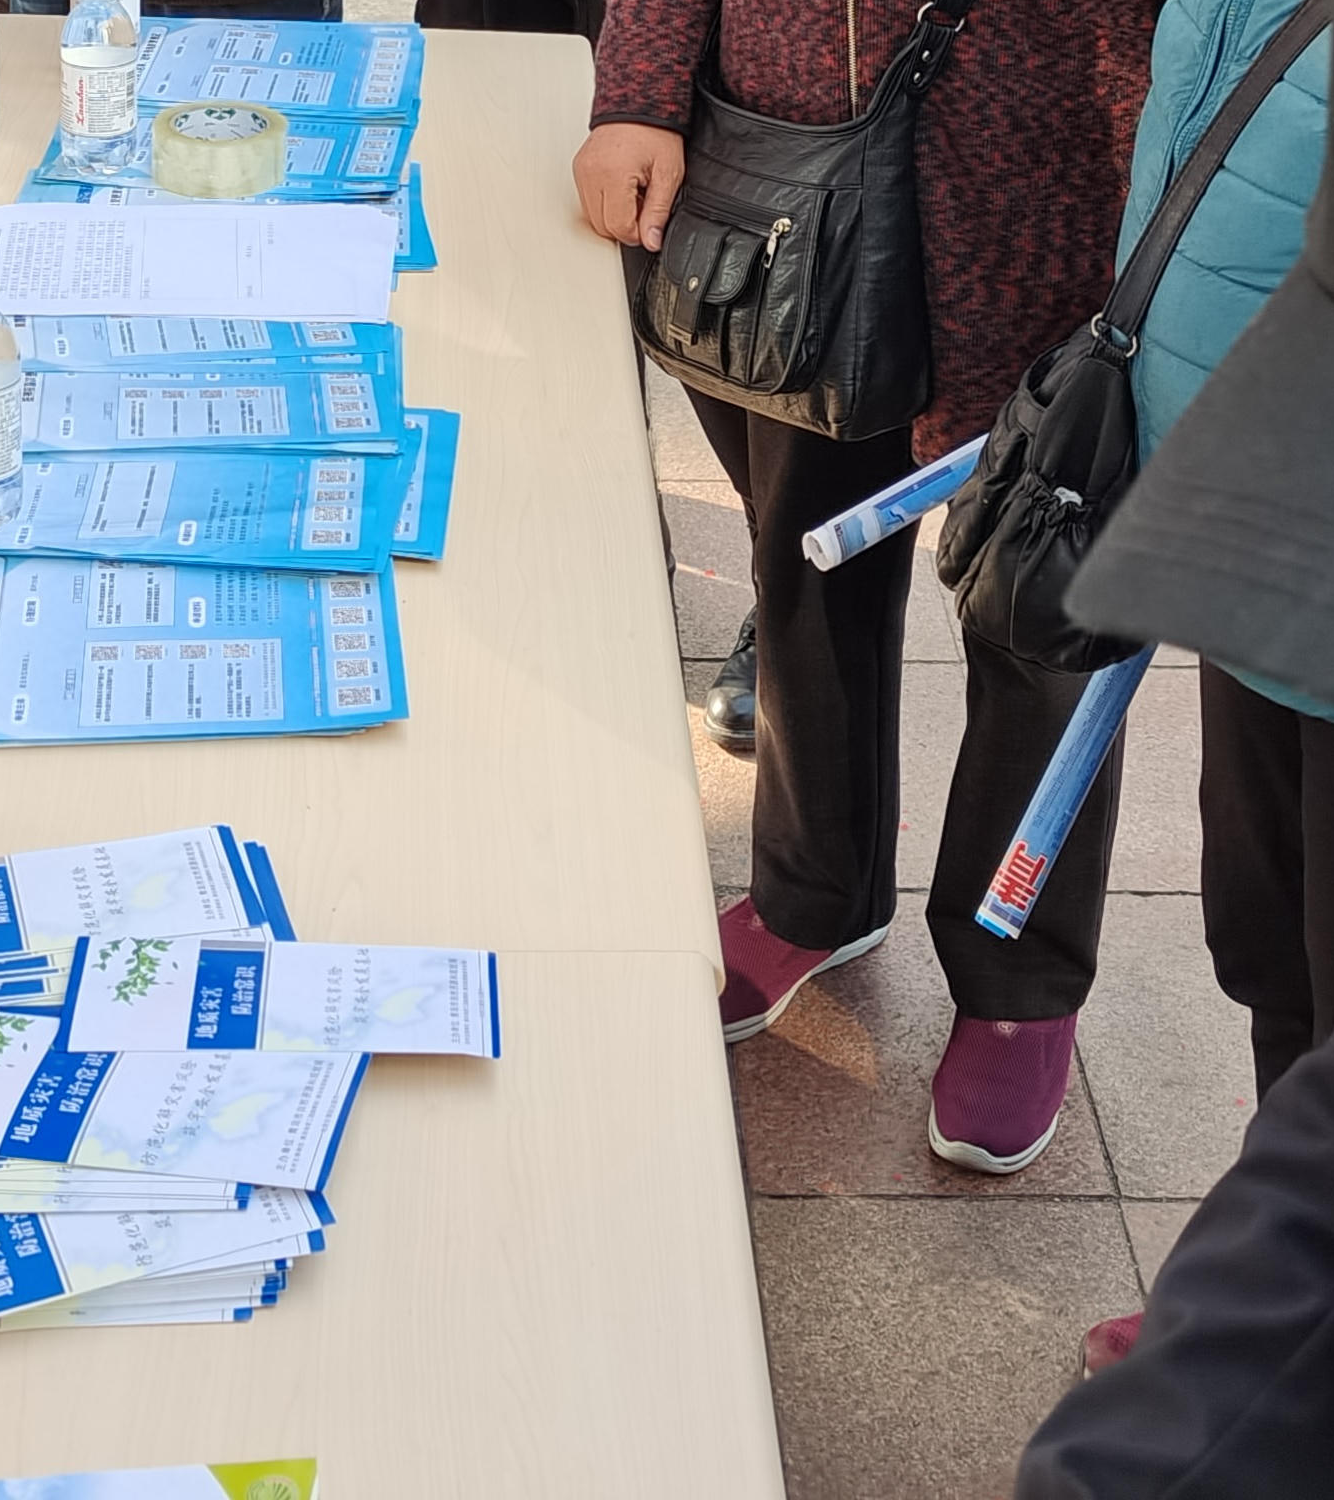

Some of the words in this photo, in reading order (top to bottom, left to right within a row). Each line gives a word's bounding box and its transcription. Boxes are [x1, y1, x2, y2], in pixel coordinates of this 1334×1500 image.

[194, 985, 223, 1040] 地质灾害
[230, 965, 258, 1016] 防治常识
[11, 1072, 66, 1145] 地质灾害
[58, 1051, 108, 1115] 防治常识
